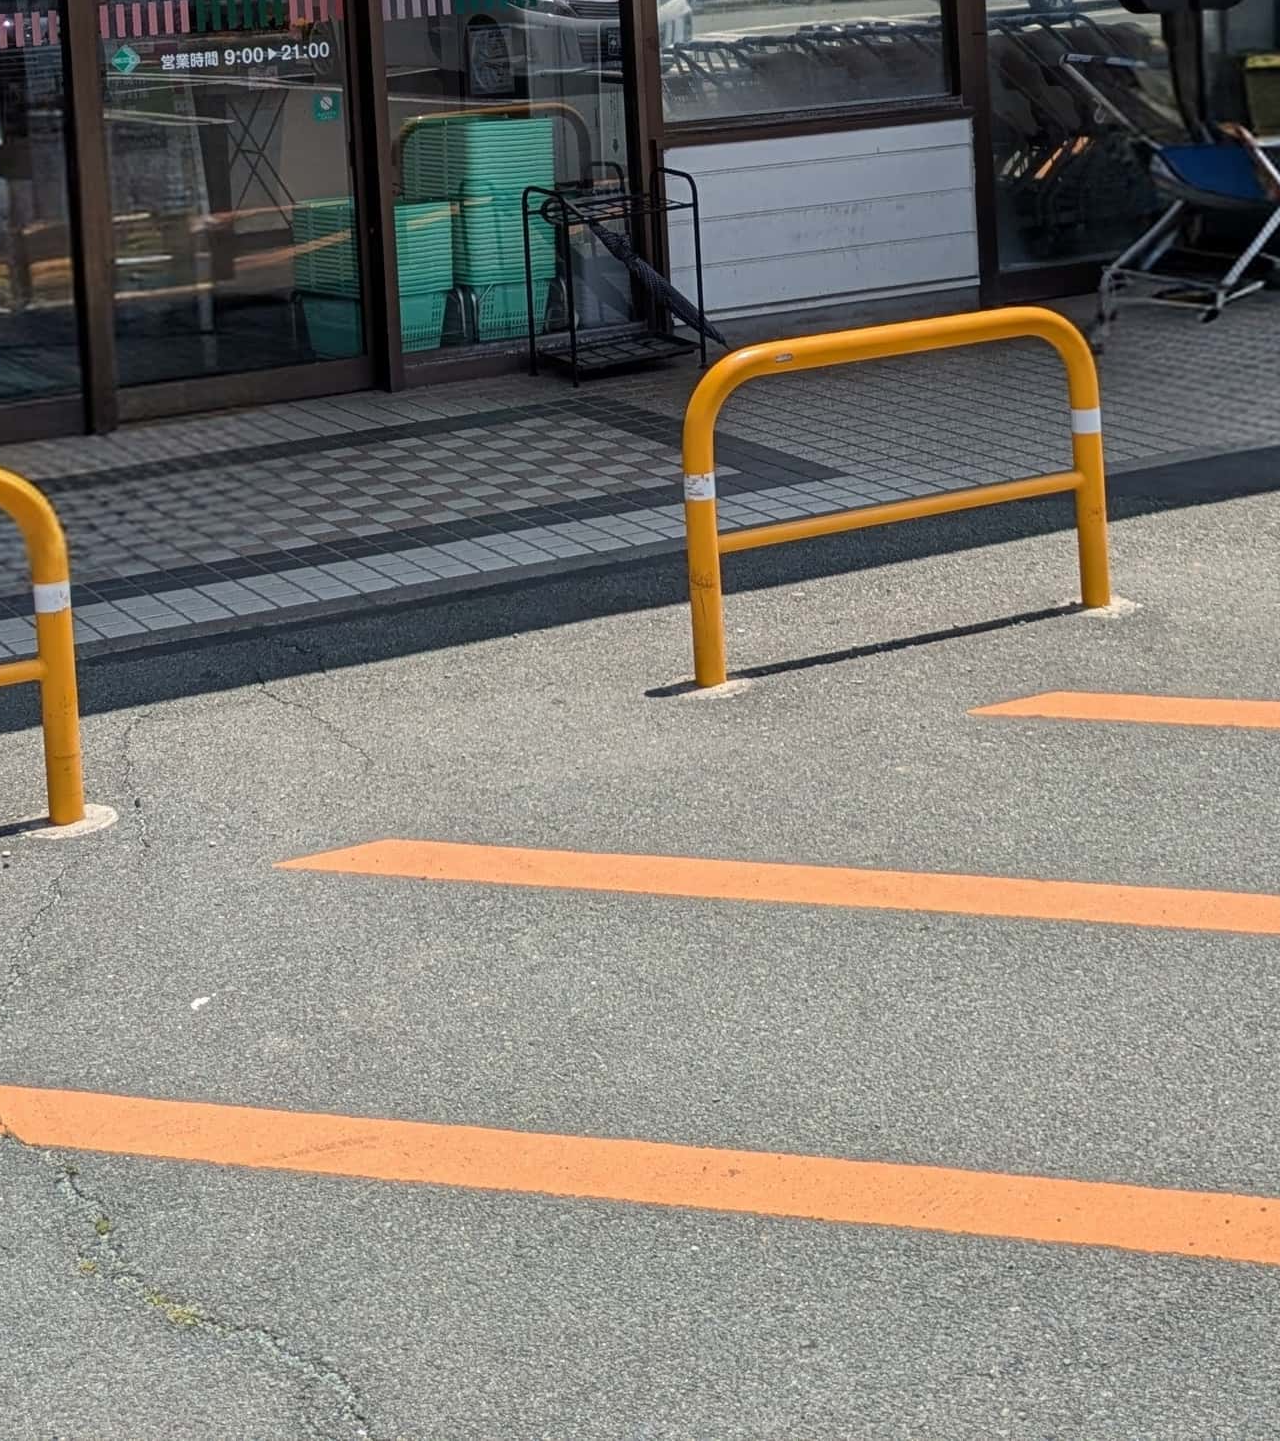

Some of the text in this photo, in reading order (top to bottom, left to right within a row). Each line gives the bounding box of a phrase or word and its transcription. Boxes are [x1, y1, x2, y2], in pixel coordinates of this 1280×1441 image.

[160, 41, 330, 71] 営業時間 9:00 21:00
